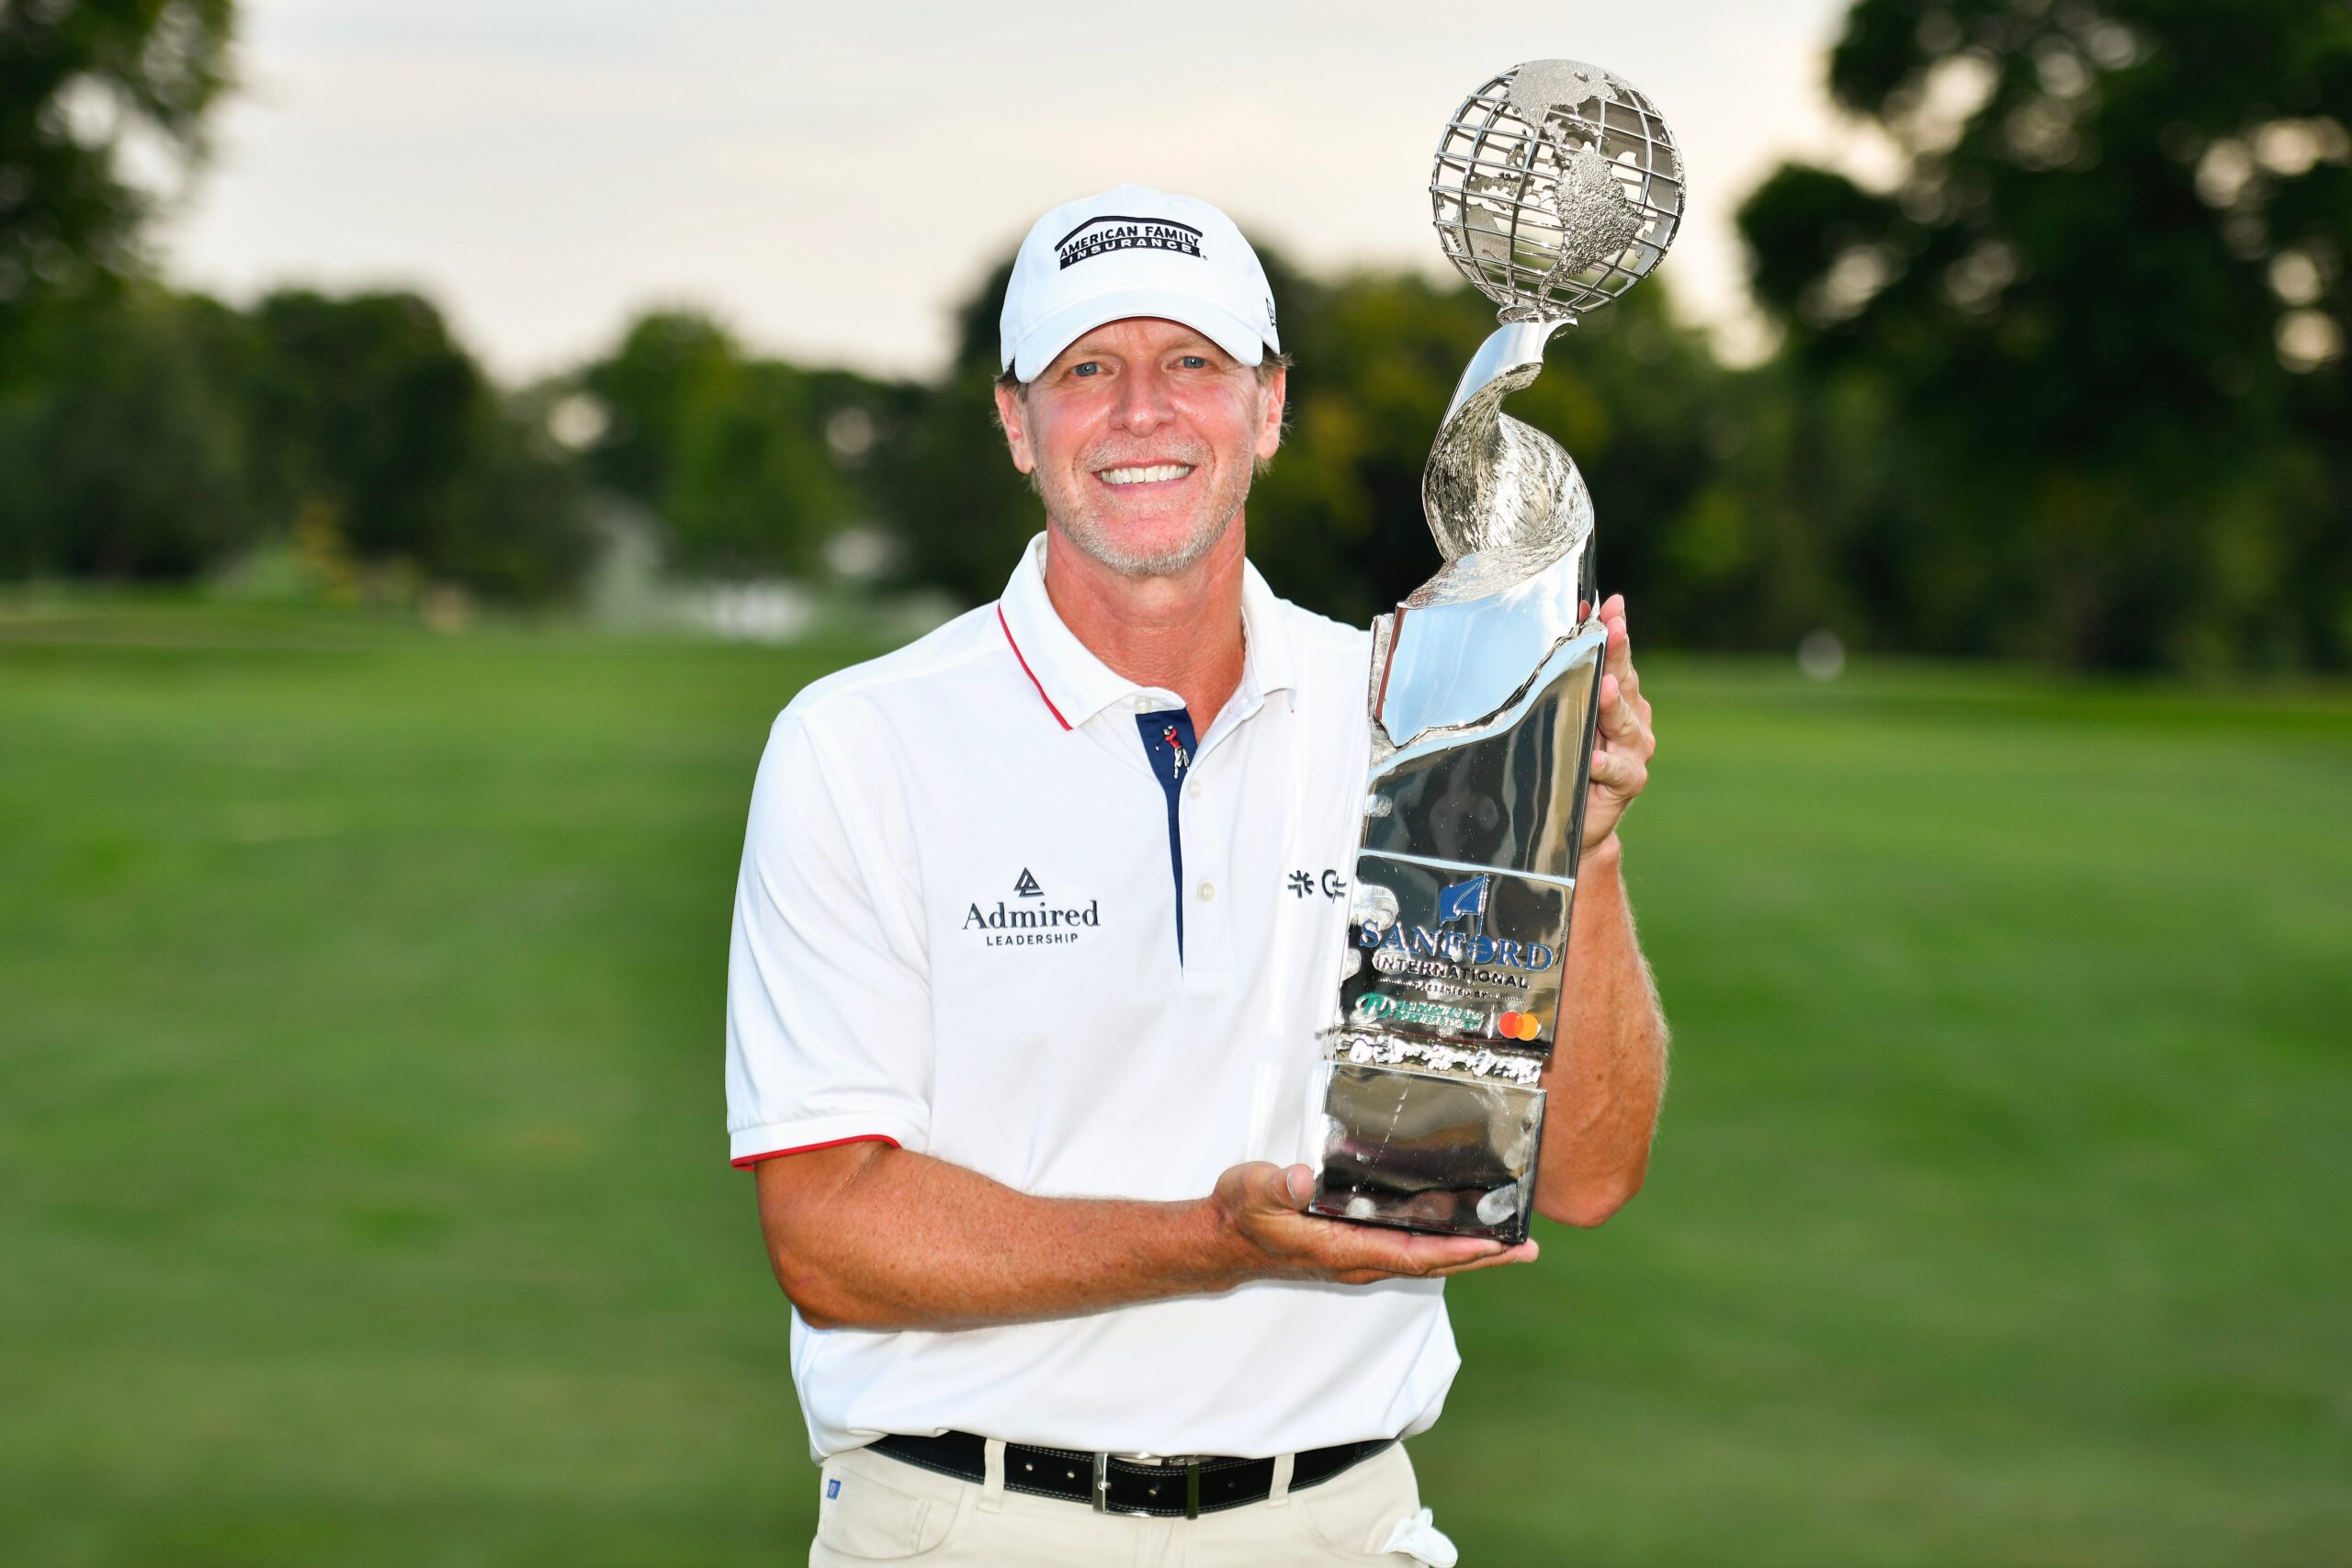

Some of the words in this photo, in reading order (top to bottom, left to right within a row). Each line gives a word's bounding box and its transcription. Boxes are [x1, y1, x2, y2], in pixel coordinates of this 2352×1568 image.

[1060, 226, 1138, 260] AMERICAN
[1145, 226, 1199, 246] FAMILY
[1069, 238, 1193, 264] INSURANCE
[961, 899, 1101, 931] Admired
[986, 932, 1079, 947] LEADERSHIP
[1359, 919, 1555, 971] SANFORD
[1378, 954, 1529, 989] INTERNATIONAL
